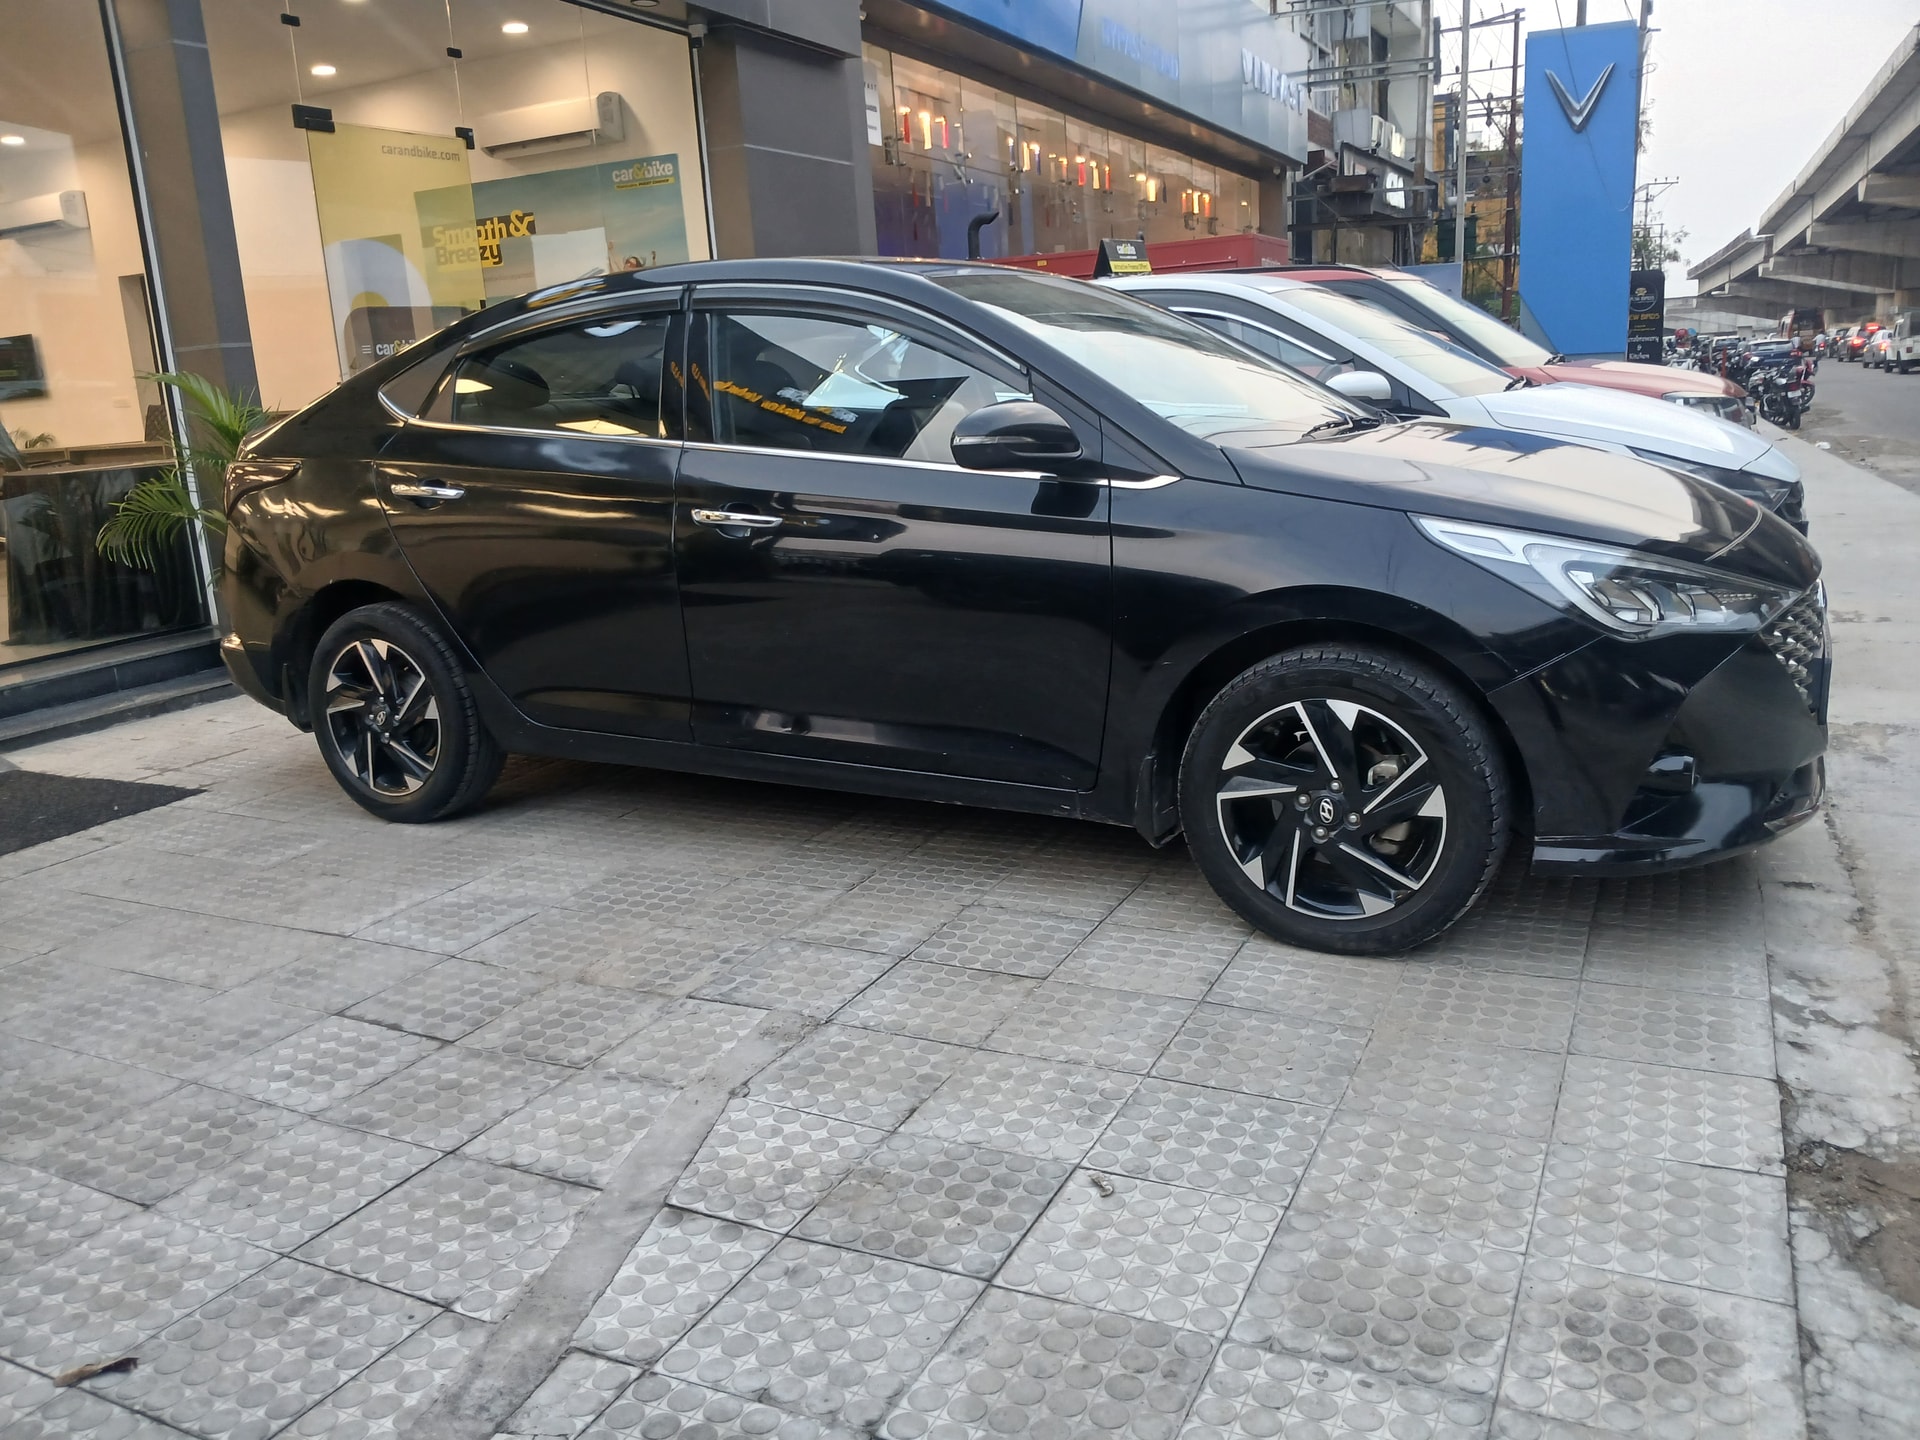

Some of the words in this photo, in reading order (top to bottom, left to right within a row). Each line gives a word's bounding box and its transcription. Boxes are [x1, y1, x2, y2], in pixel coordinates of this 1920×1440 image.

[1241, 47, 1306, 115] VINFAST
[381, 145, 461, 161] carandbike.com
[612, 160, 674, 182] car&bike
[432, 216, 508, 247] Smooth
[509, 209, 534, 237] &
[435, 243, 504, 266] Breezy
